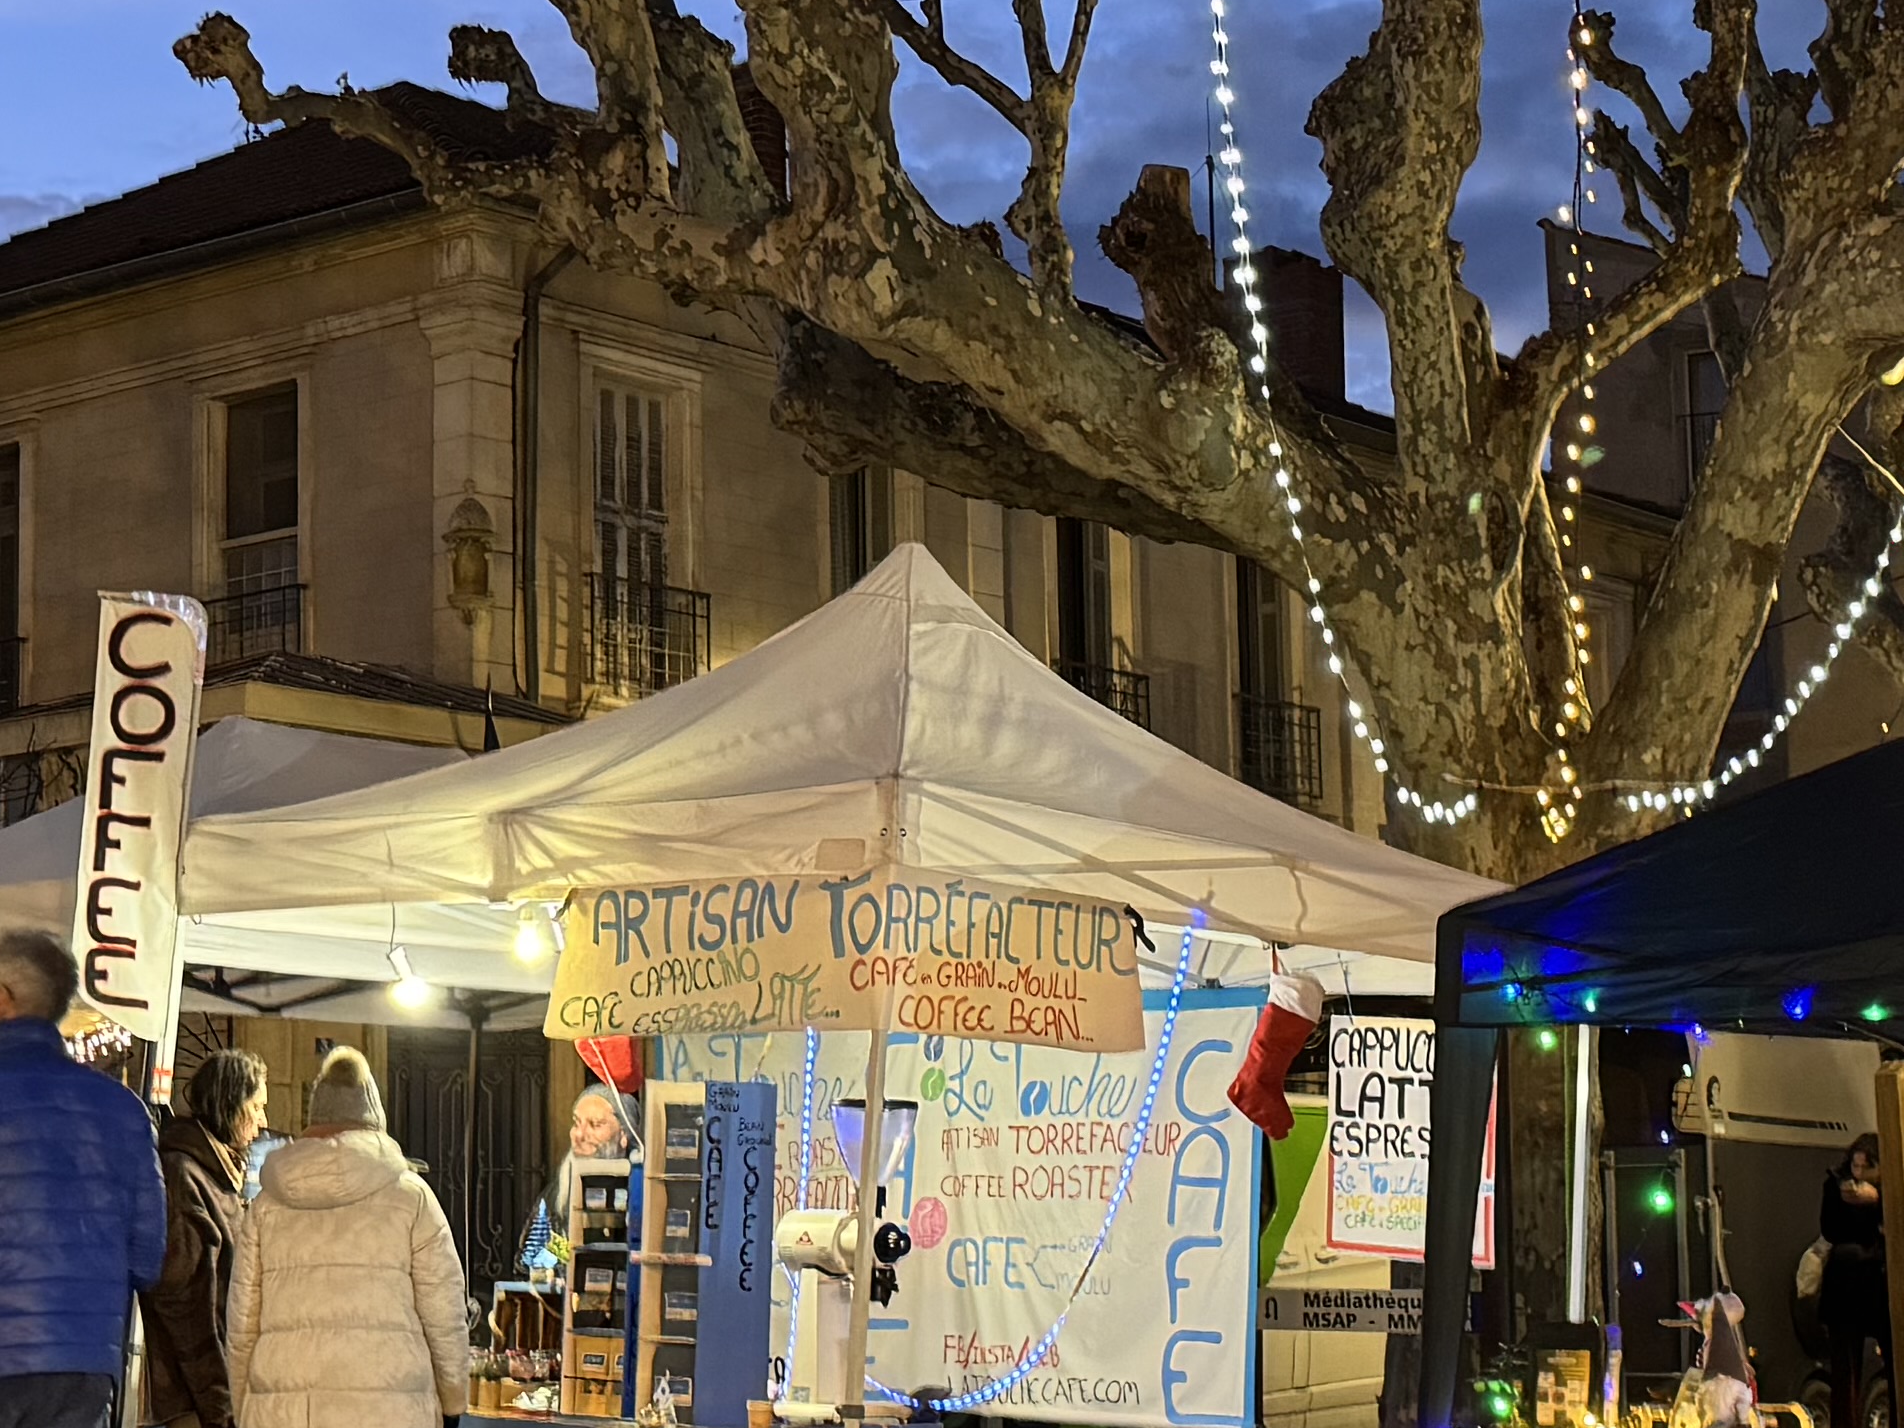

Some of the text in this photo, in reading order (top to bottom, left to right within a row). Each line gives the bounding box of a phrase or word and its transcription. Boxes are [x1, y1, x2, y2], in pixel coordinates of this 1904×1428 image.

[85, 611, 176, 1010] COFFEE
[593, 872, 1135, 976] ARTISAN TORRÉFACTEUR
[936, 960, 996, 990] GRAIN
[898, 994, 994, 1034] COFFEE
[943, 1039, 993, 1121] La
[1009, 1122, 1181, 1157] TORREFACEUR
[1330, 1122, 1431, 1159] ESPRES
[940, 1174, 1006, 1200] COFFEE
[1162, 1038, 1238, 1424] CAFE
[947, 1237, 1026, 1289] CAFE
[1303, 1290, 1423, 1316] Médiathèqu
[1303, 1312, 1357, 1329] MSAP
[1388, 1313, 1423, 1331] MM
